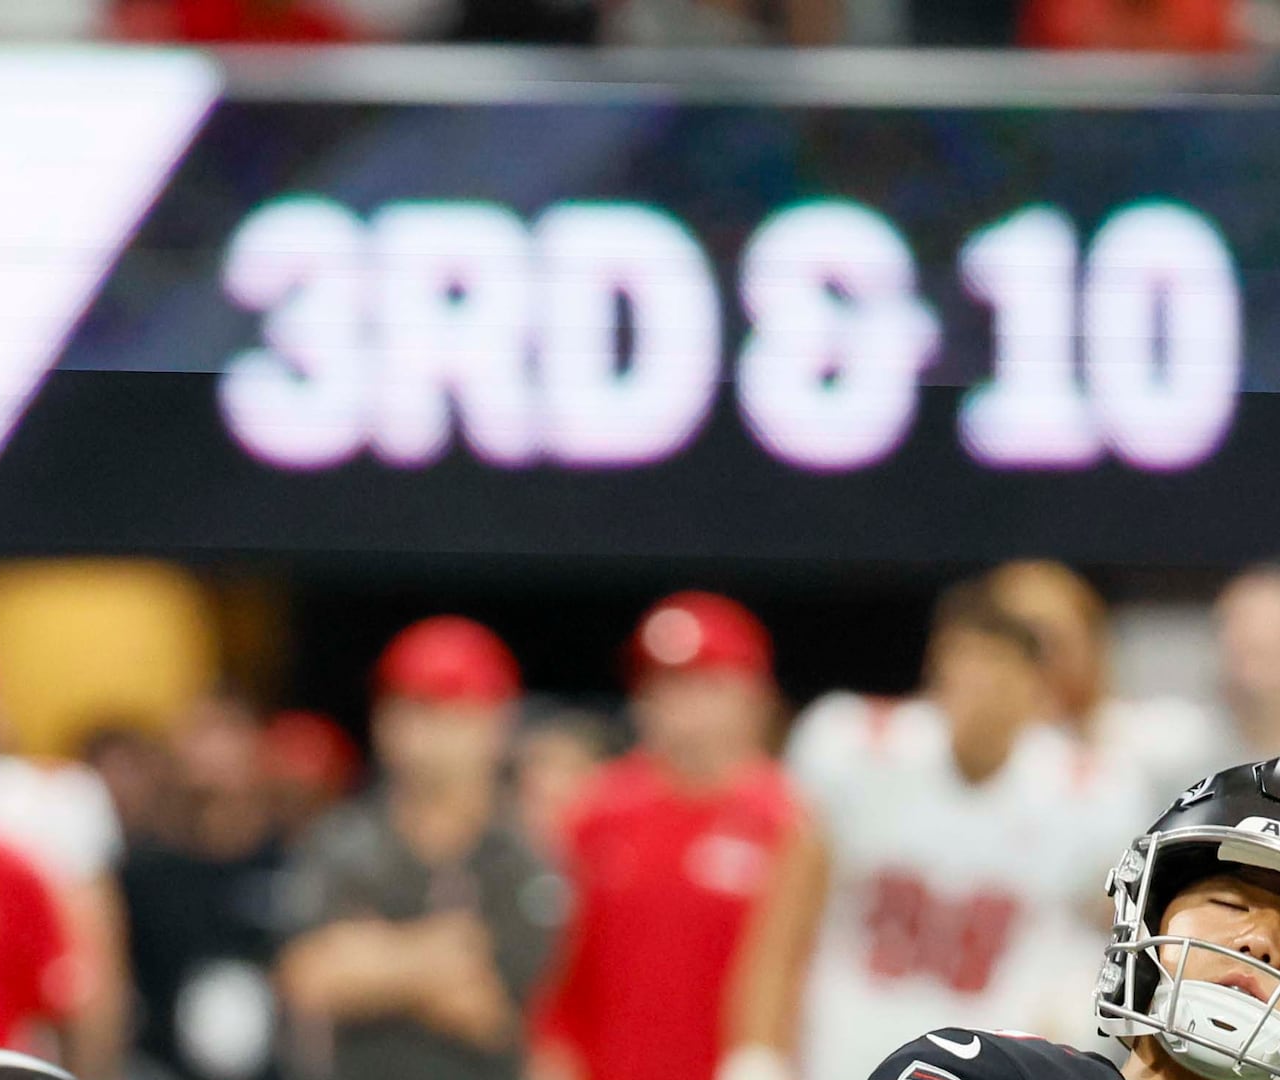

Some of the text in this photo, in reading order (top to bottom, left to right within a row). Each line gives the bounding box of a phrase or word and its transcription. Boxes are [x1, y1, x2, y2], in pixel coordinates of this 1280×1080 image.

[222, 198, 1242, 470] 3RD & 10
